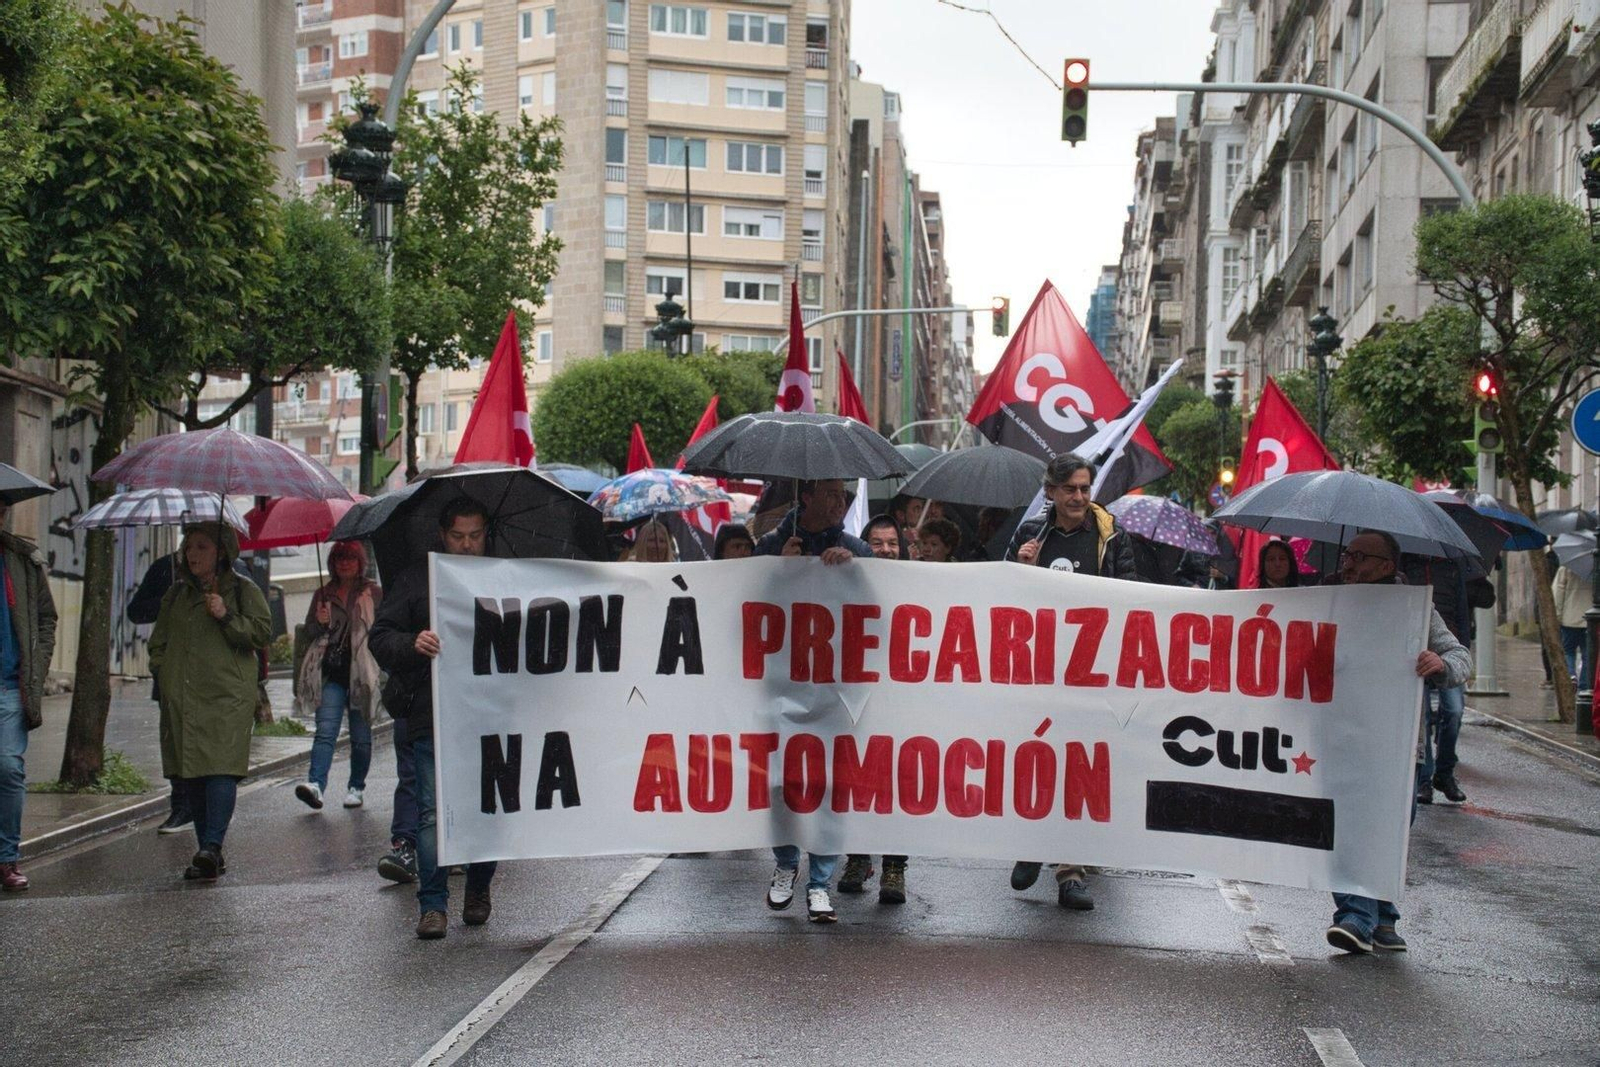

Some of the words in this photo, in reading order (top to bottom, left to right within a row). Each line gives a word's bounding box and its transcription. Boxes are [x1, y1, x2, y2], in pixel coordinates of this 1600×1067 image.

[472, 594, 625, 676] NON
[655, 574, 704, 676] À
[742, 602, 1337, 704] PRECARIZACIÓN
[480, 731, 582, 815] NA
[633, 717, 1111, 823] AUTOMOCIÓN
